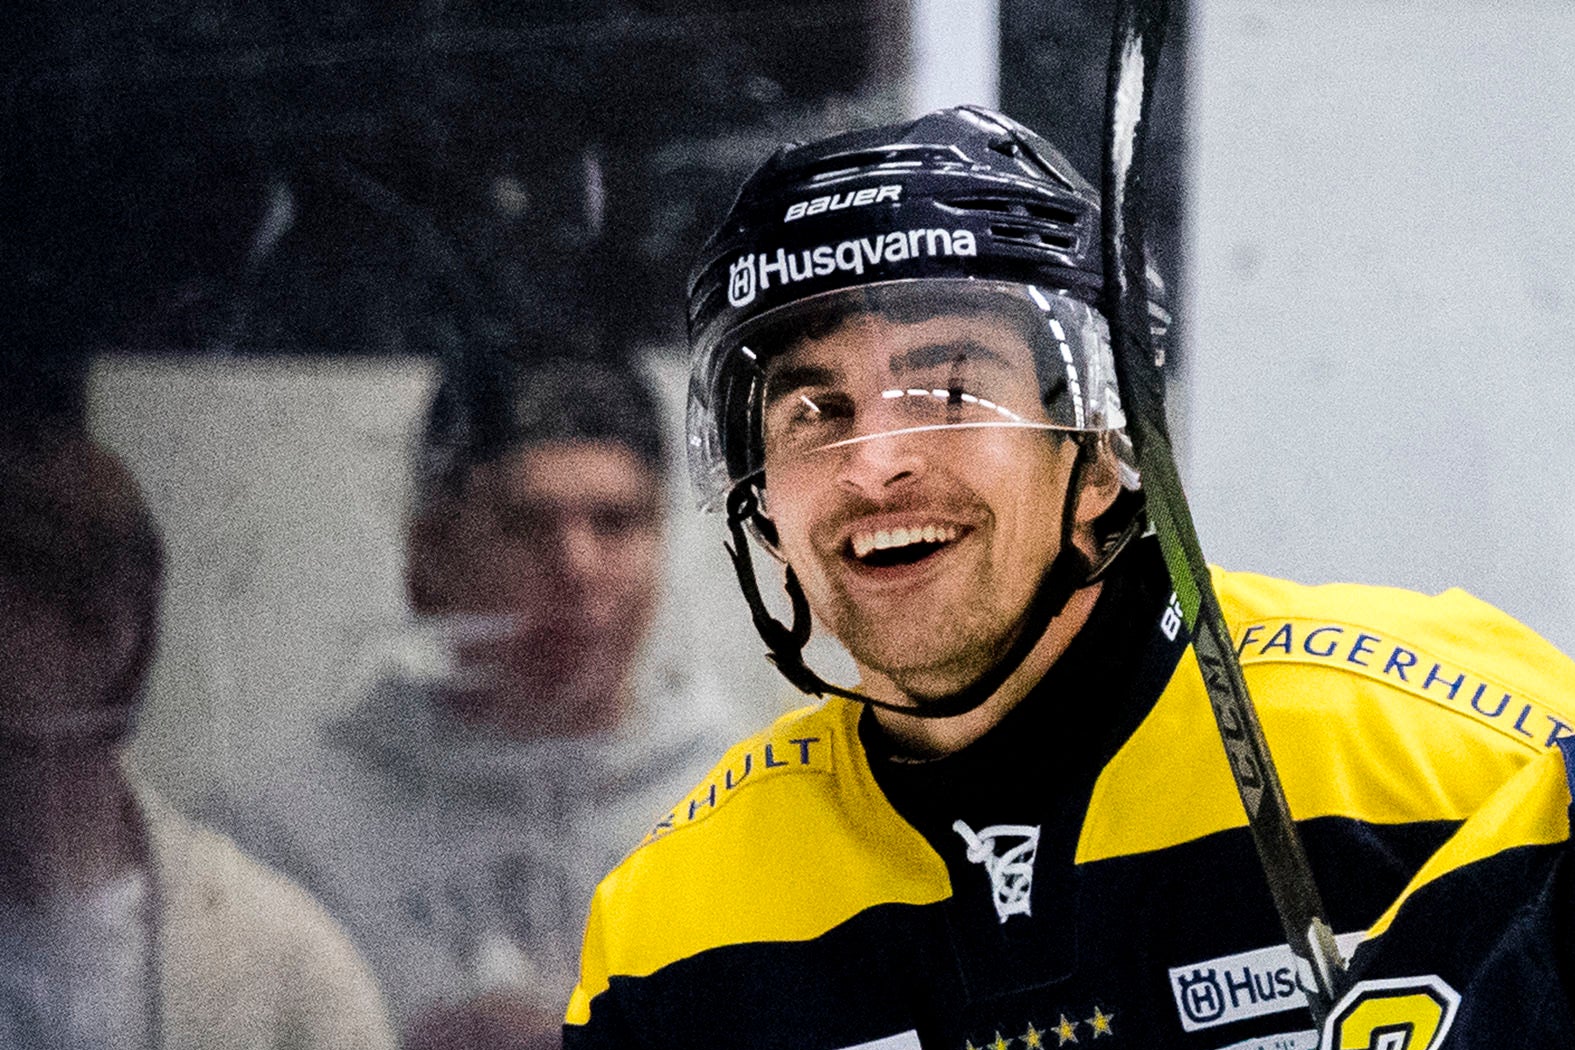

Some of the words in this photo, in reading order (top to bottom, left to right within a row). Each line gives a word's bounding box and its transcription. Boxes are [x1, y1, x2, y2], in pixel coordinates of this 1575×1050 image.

[783, 184, 903, 223] BAUER
[757, 226, 977, 290] Husqvarna
[1236, 623, 1574, 748] FAGERHULT
